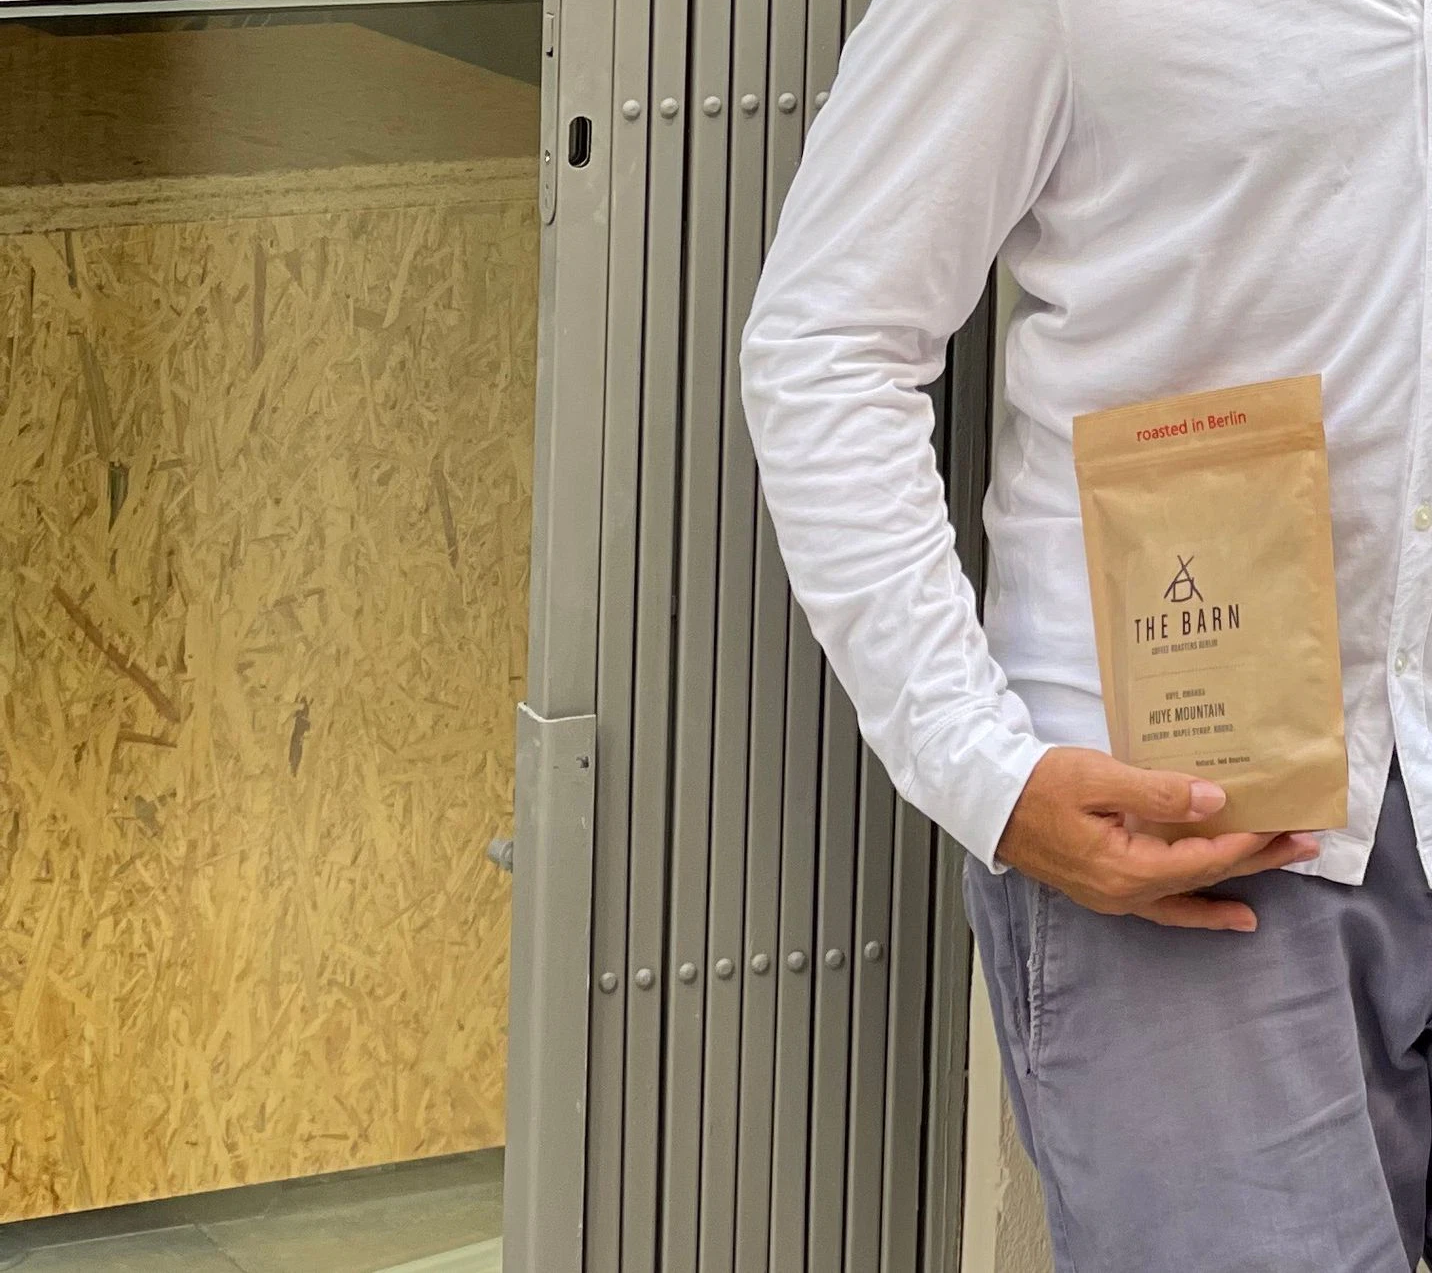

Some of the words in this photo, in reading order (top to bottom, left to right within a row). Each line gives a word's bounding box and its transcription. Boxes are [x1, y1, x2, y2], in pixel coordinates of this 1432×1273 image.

[1136, 419, 1188, 441] roasted
[1192, 418, 1204, 432] in
[1207, 411, 1247, 429] Berlin
[1135, 614, 1168, 643] THE
[1182, 604, 1240, 635] BARN
[1149, 709, 1171, 725] HUYE
[1175, 702, 1225, 721] MOUNTAIN
